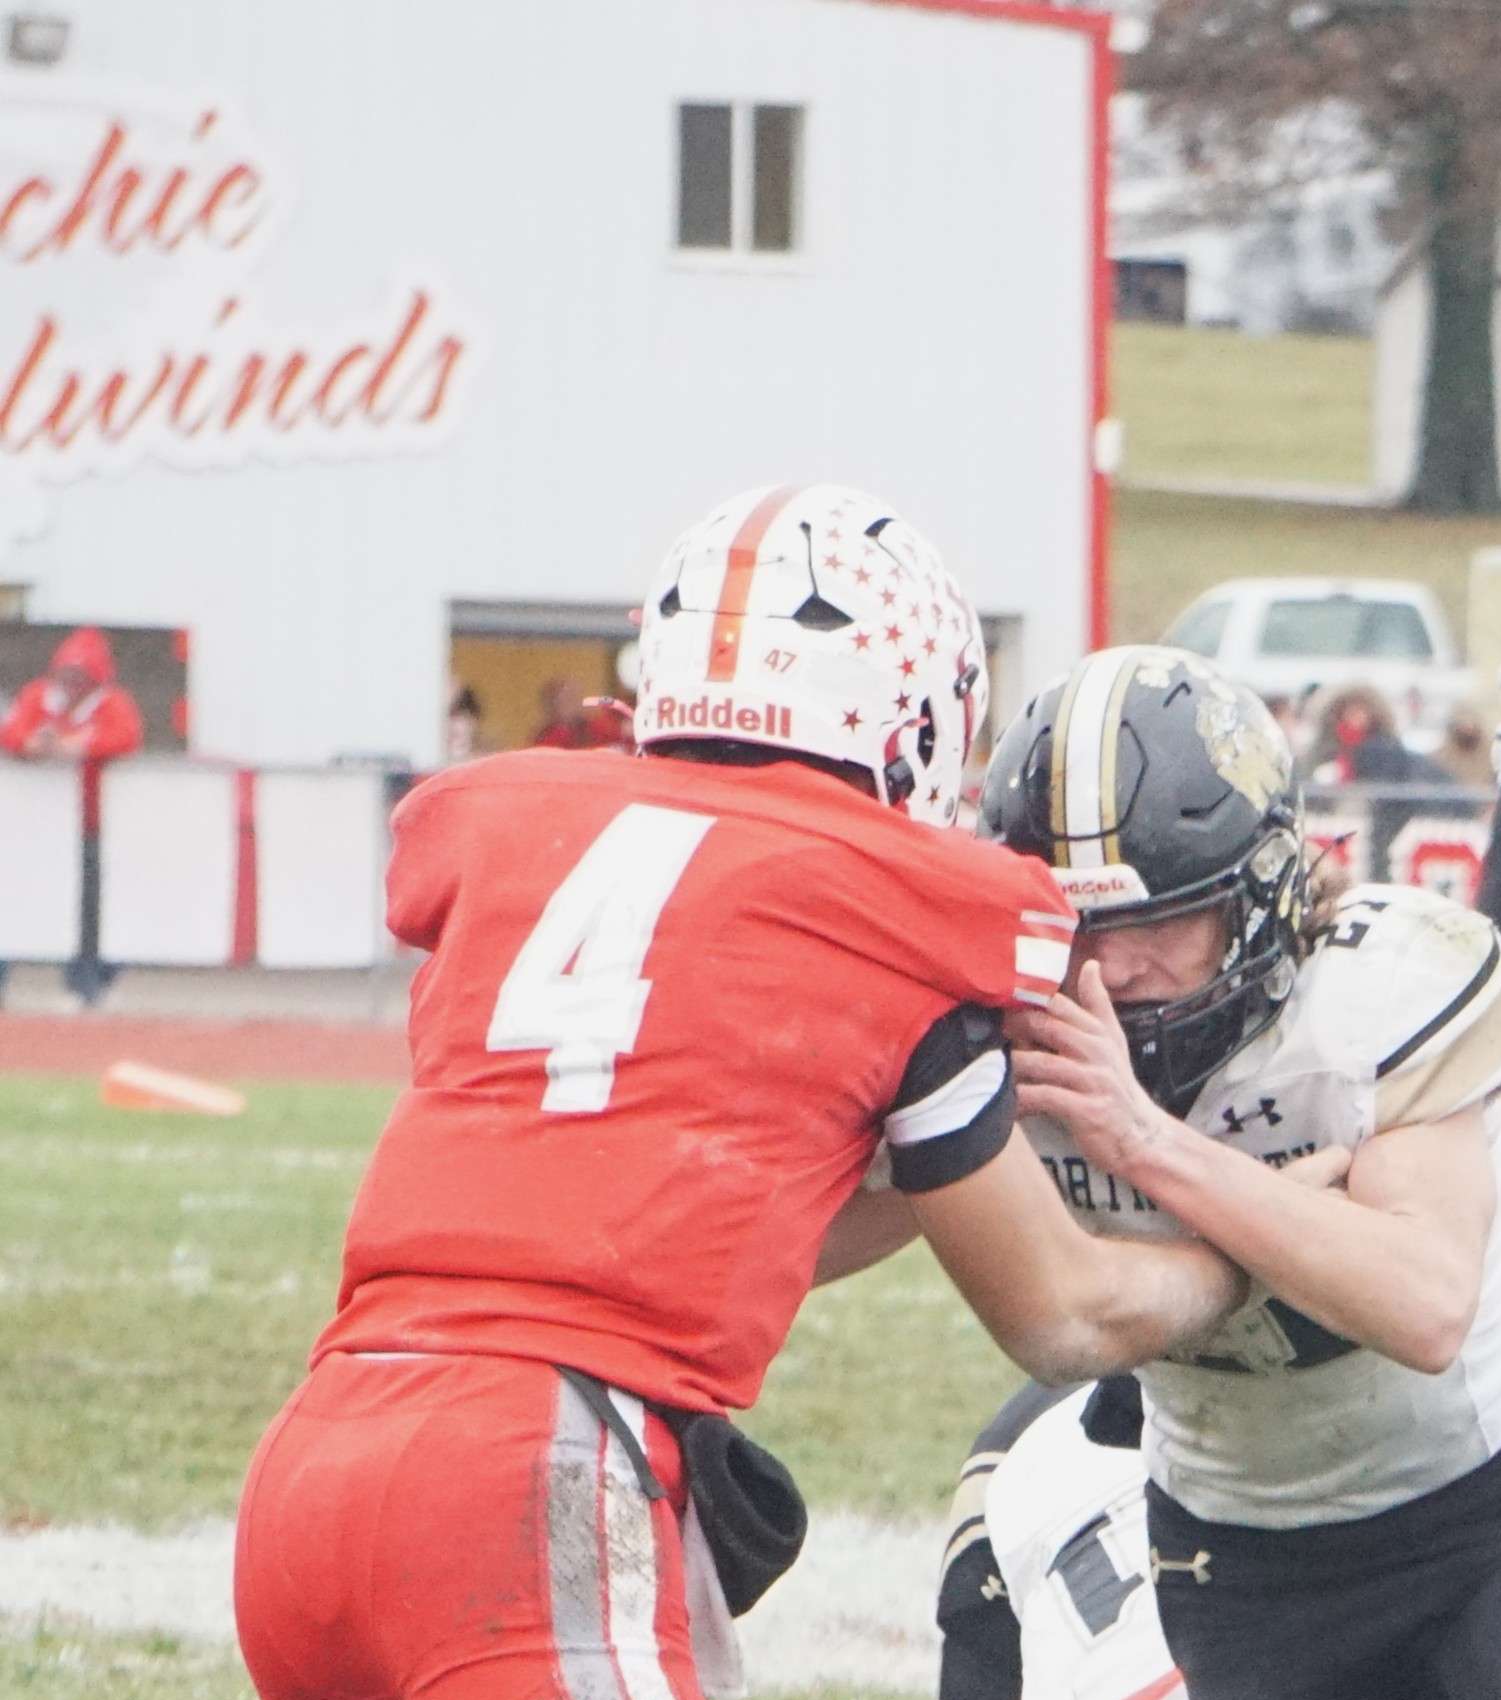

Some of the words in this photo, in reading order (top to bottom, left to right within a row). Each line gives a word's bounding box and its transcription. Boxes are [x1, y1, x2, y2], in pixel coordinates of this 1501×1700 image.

[764, 648, 797, 674] 47
[656, 694, 791, 739] Riddell
[486, 802, 718, 1113] 4
